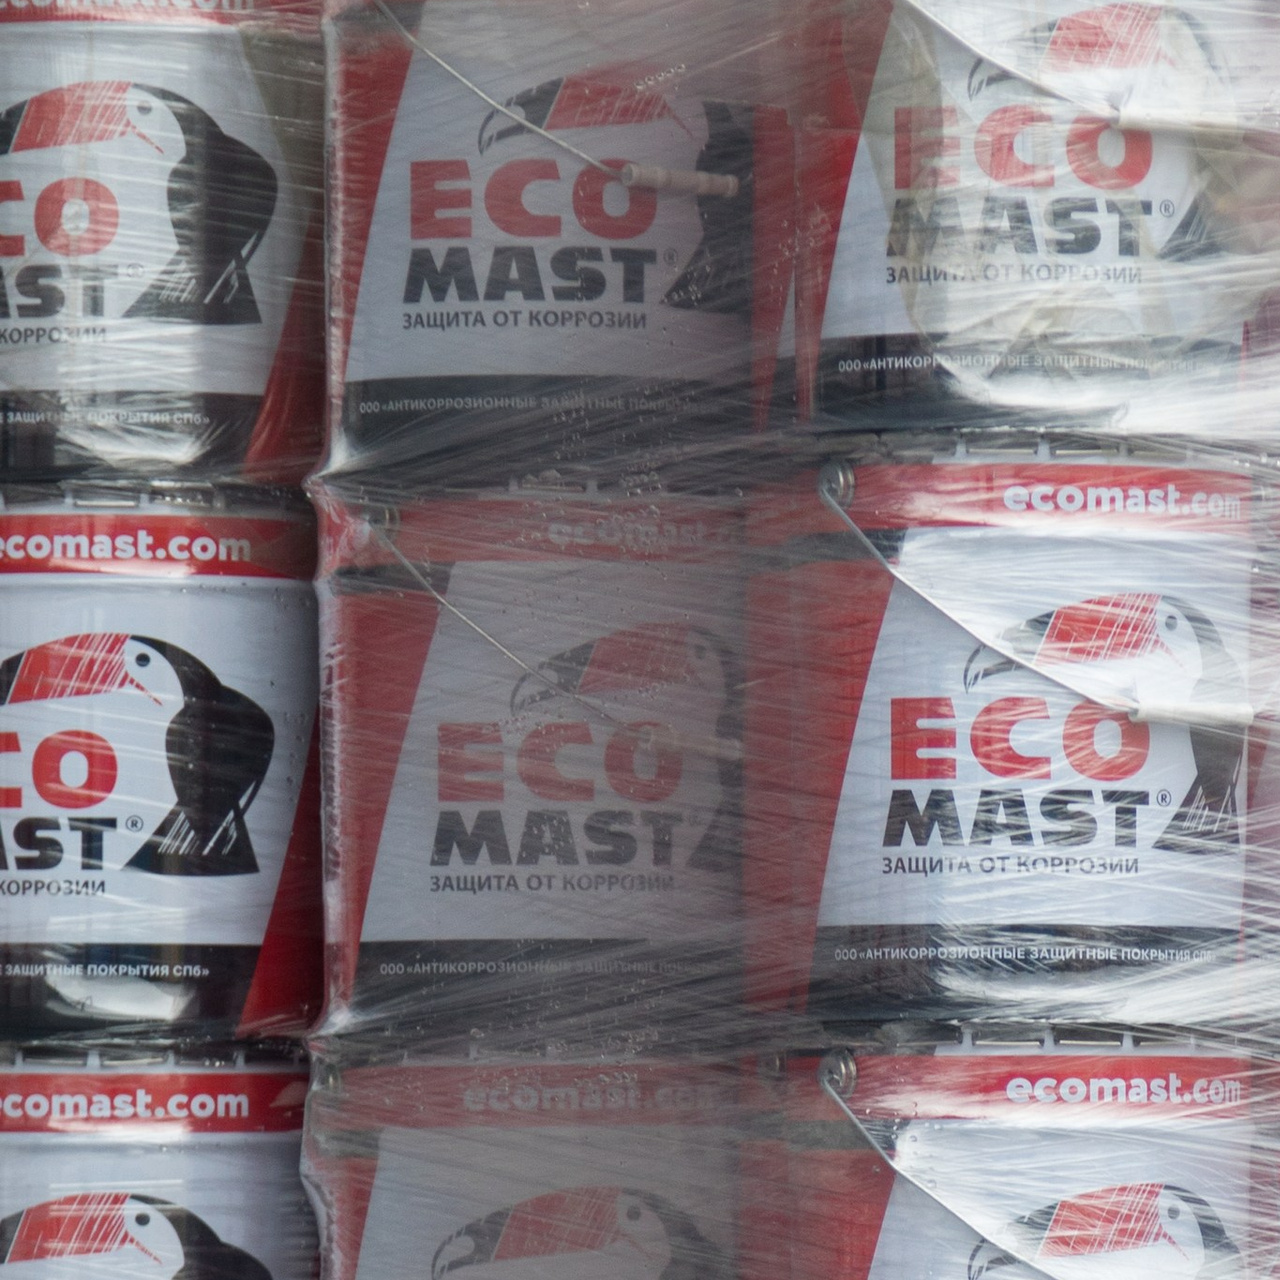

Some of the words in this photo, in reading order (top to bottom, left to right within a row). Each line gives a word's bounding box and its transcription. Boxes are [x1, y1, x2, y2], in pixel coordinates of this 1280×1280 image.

[894, 104, 1154, 190] ECO
[410, 159, 658, 241] ECO
[886, 196, 1153, 257] MAST
[0, 263, 119, 319] ST
[402, 246, 658, 304] MAST
[402, 311, 487, 331] ЗАЩИТА
[493, 310, 522, 328] ОТ
[528, 310, 647, 329] КОРРОЗИИ
[1004, 484, 1240, 520] ecomast.com
[0, 529, 250, 562] comast.com
[437, 722, 683, 803] ECO
[891, 696, 1151, 782] ECO
[0, 817, 118, 871] ST
[430, 809, 686, 868] MAST
[882, 788, 1150, 849] MAST
[430, 874, 519, 895] ЗАЩИТА
[526, 874, 556, 893] ОТ
[882, 856, 972, 878] ЗАЩИТА
[979, 856, 1008, 875] ОТ
[1030, 946, 1118, 963] ЗАЩИТНЫЕ
[0, 1088, 249, 1118] comast.com
[1006, 1073, 1241, 1104] ecomast.com
